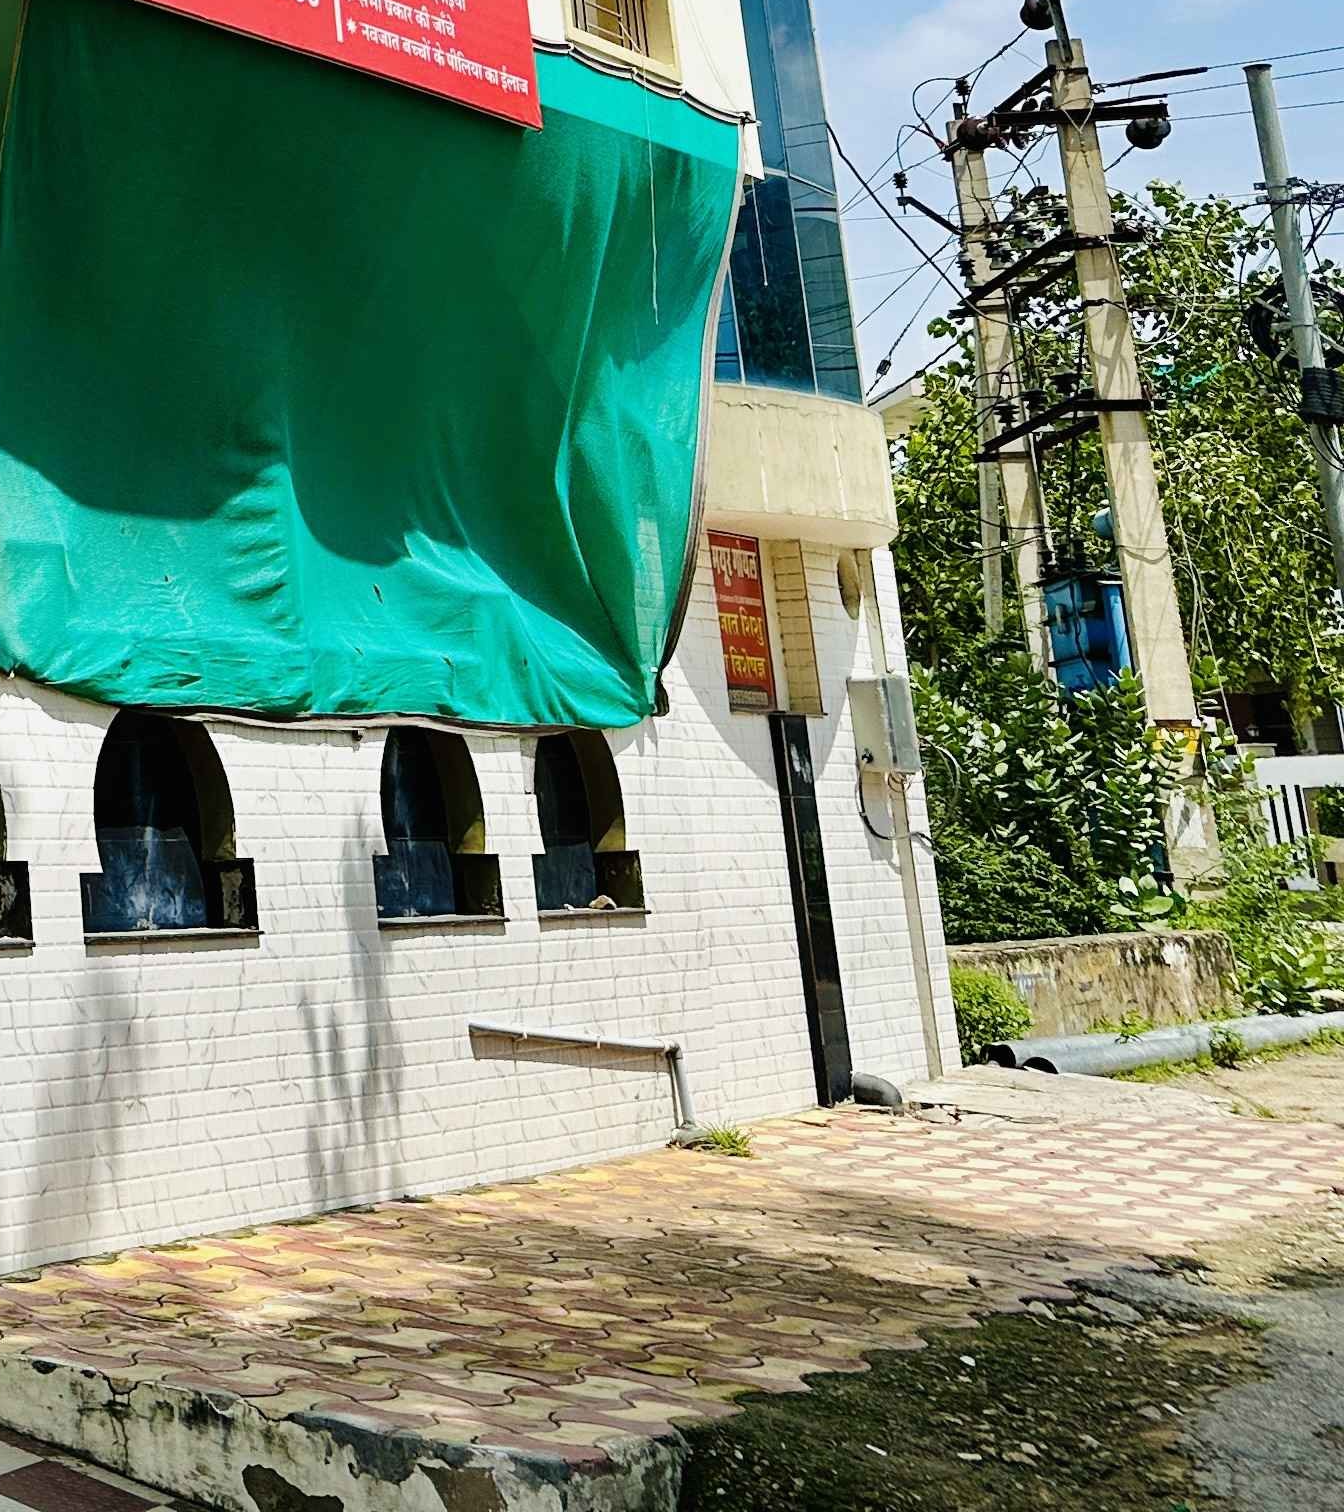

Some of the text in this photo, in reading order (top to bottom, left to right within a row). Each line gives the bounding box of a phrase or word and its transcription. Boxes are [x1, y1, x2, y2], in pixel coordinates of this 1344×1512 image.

[384, 0, 413, 25] प्रकार
[414, 5, 430, 31] की
[359, 22, 400, 52] नवजात
[432, 42, 446, 67] के
[483, 64, 499, 88] का
